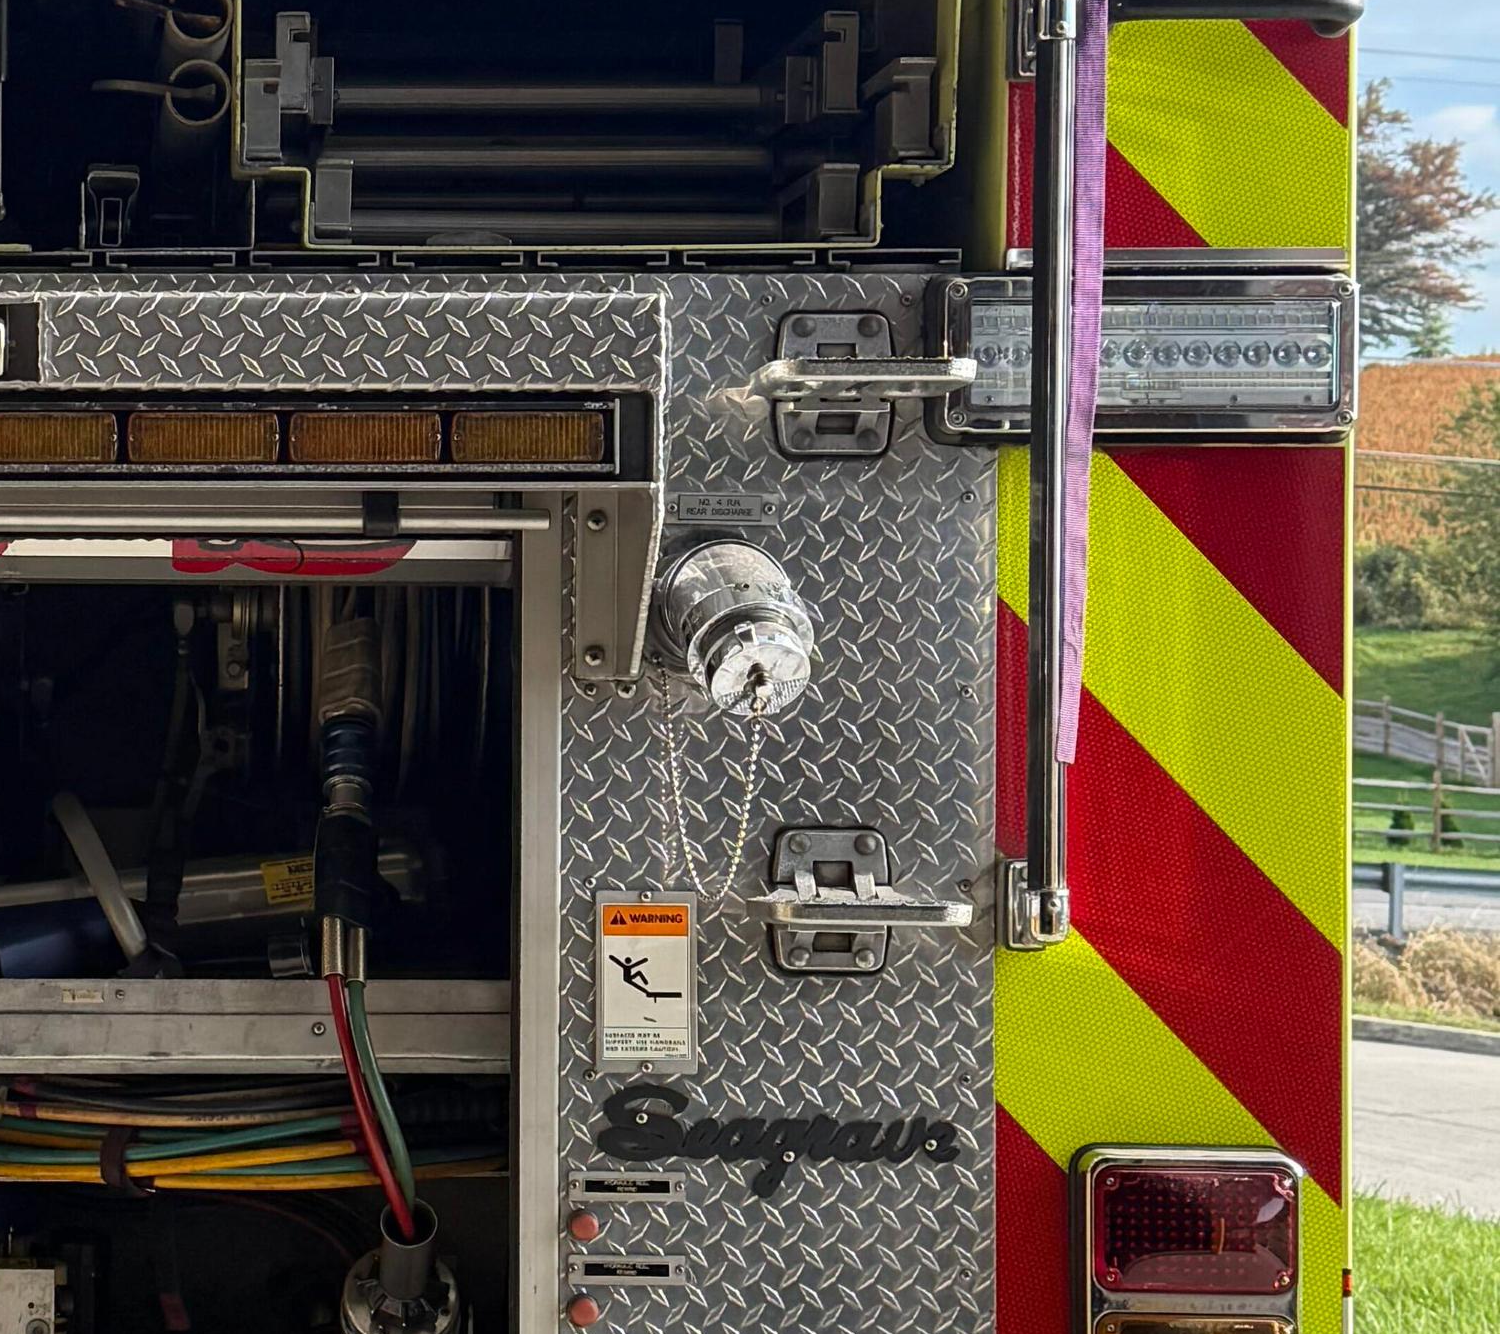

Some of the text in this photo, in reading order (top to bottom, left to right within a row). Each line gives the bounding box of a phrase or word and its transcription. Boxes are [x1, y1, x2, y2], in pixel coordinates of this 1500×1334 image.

[686, 507, 707, 515] REAR
[629, 913, 683, 924] WARNING
[597, 1083, 961, 1199] Seagrave
